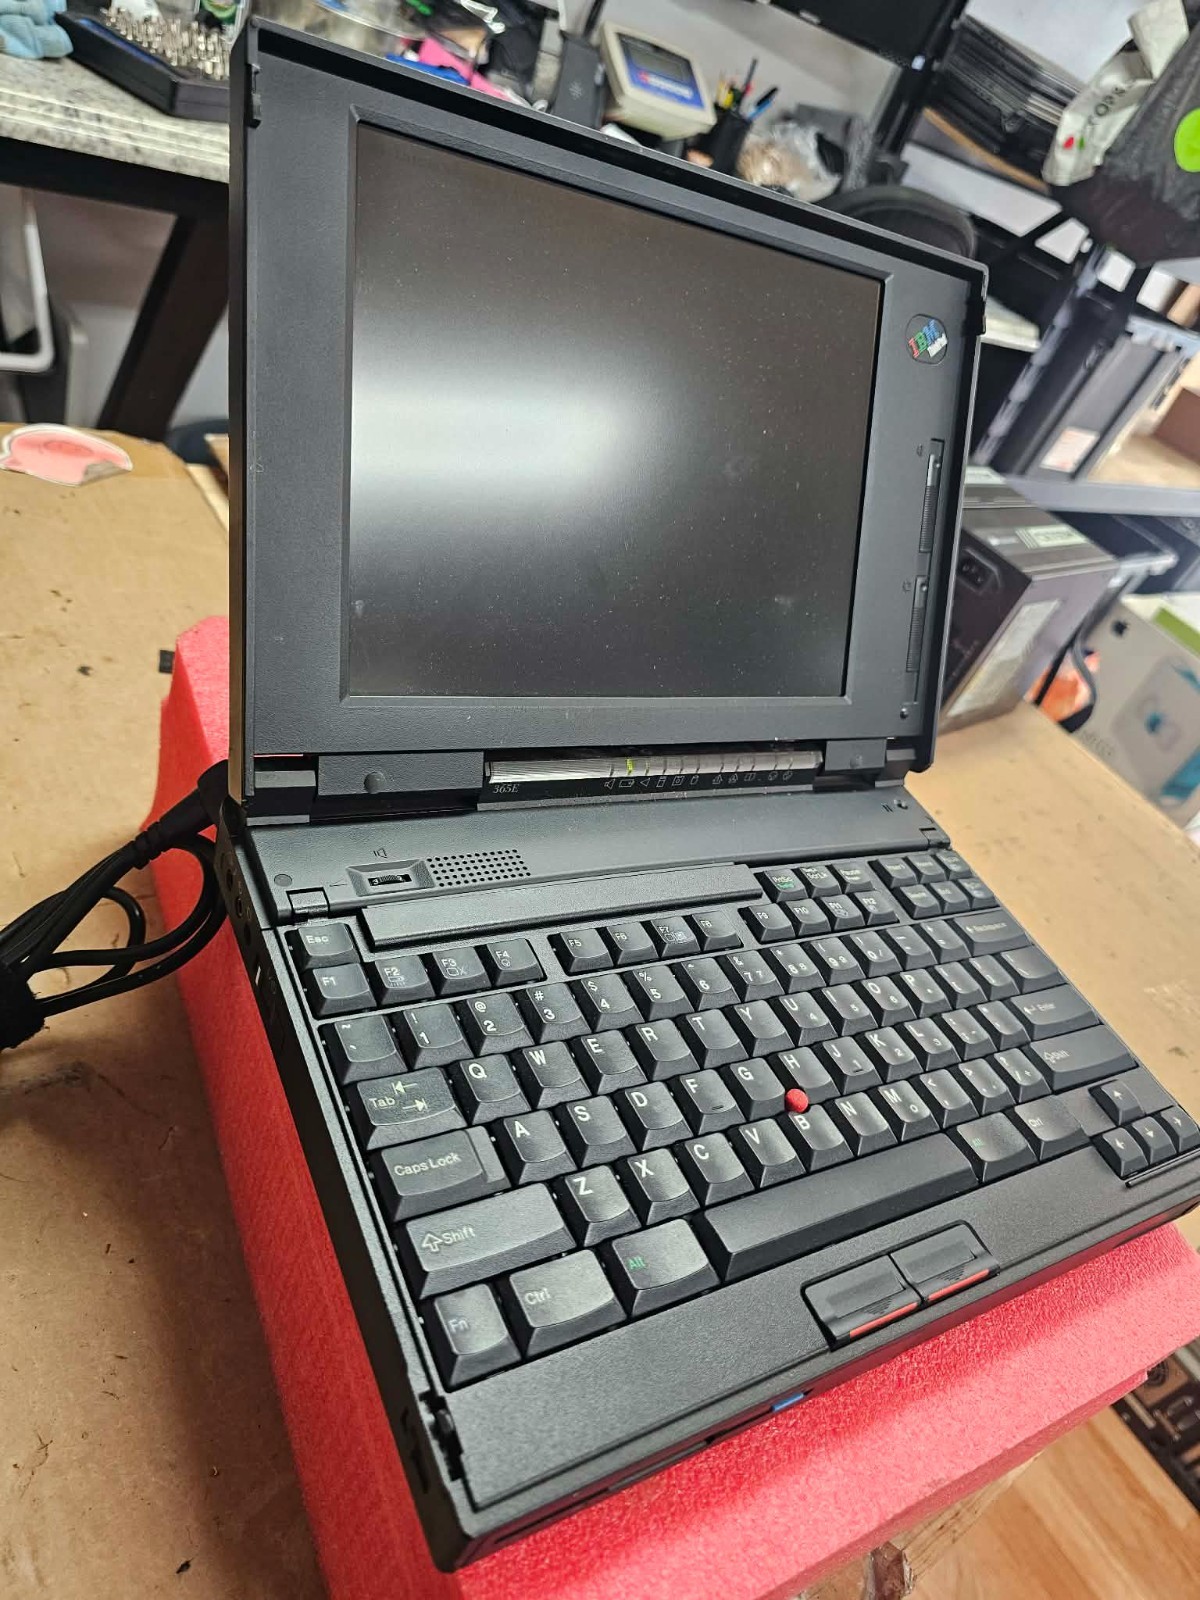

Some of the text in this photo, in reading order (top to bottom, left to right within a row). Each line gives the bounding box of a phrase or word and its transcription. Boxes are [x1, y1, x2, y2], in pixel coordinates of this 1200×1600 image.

[908, 318, 942, 359] IBM
[493, 784, 519, 794] 365E
[757, 911, 769, 919] F9
[794, 907, 810, 915] F10
[700, 920, 713, 928] F8
[306, 935, 329, 944] Esc
[568, 939, 582, 947] F5
[615, 932, 628, 941] F6
[496, 950, 510, 958] F4
[867, 950, 878, 960] 0
[441, 958, 457, 967] F3
[828, 957, 840, 967] 9
[384, 967, 400, 976] F2
[788, 964, 799, 974] 8
[322, 976, 337, 986] F1
[639, 971, 652, 982] %
[744, 972, 753, 981] 7
[904, 974, 916, 987] P
[699, 980, 710, 990] 6
[867, 982, 881, 994] O
[534, 990, 545, 1001] #
[650, 988, 662, 999] 5
[825, 990, 837, 1003] I
[474, 1001, 487, 1013] @
[600, 999, 610, 1009] 4
[784, 998, 799, 1011] U
[543, 1008, 556, 1020] 3
[740, 1007, 753, 1020] Y
[483, 1020, 497, 1032] 2
[692, 1016, 706, 1031] T
[641, 1027, 659, 1042] R
[908, 1024, 924, 1037] L
[420, 1031, 430, 1044] 1
[869, 1033, 887, 1047] K
[587, 1038, 604, 1054] E
[831, 1044, 841, 1058] J
[529, 1049, 547, 1066] W
[783, 1054, 801, 1069] H
[469, 1063, 487, 1079] Q
[737, 1066, 754, 1081] G
[685, 1078, 699, 1094] F
[630, 1091, 648, 1107] D
[883, 1088, 902, 1103] M
[369, 1096, 395, 1109] Tab
[840, 1101, 857, 1116] N
[573, 1105, 591, 1122] S
[514, 1120, 531, 1138] A
[794, 1115, 810, 1130] B
[745, 1128, 760, 1144] V
[694, 1144, 709, 1159] C
[634, 1160, 654, 1177] X
[573, 1176, 594, 1195] Z
[441, 1226, 476, 1244] Shift
[628, 1256, 646, 1269] Alt
[523, 1287, 550, 1305] Ctrl
[448, 1318, 469, 1333] Fn
